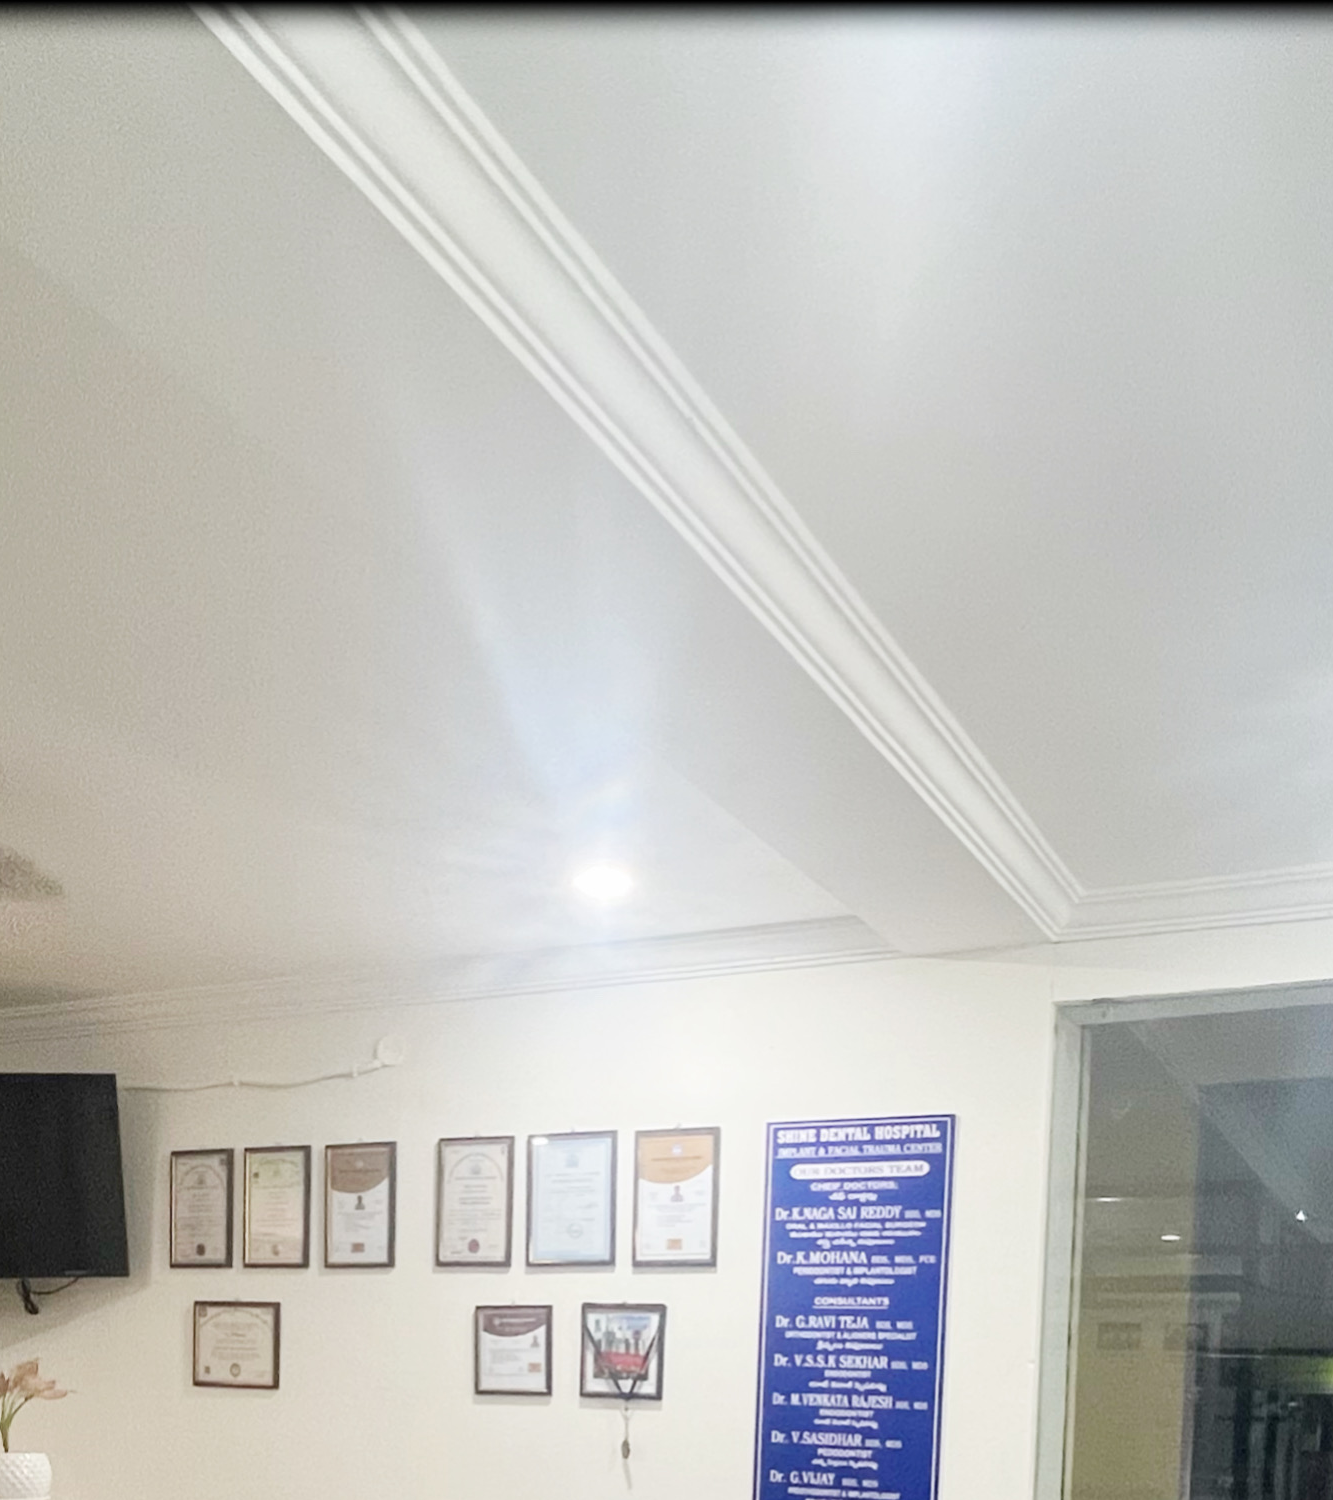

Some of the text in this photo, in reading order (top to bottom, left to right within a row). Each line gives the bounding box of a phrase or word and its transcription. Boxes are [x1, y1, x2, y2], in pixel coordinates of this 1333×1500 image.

[776, 1124, 941, 1144] SHINE DENTAL HOSPITAL
[823, 1164, 884, 1176] DOCTORS
[887, 1163, 924, 1174] TEAM
[837, 1206, 857, 1220] SAI
[860, 1205, 902, 1219] REDDY
[813, 1296, 890, 1306] CONSULTANTS
[795, 1315, 836, 1329] G.RAVI
[838, 1316, 869, 1329] TEJA
[839, 1355, 889, 1369] SEKHAR
[851, 1395, 893, 1409] RAJESH
[791, 1431, 863, 1447] V.SASIDHAR
[789, 1470, 836, 1485] G.VIJAY
